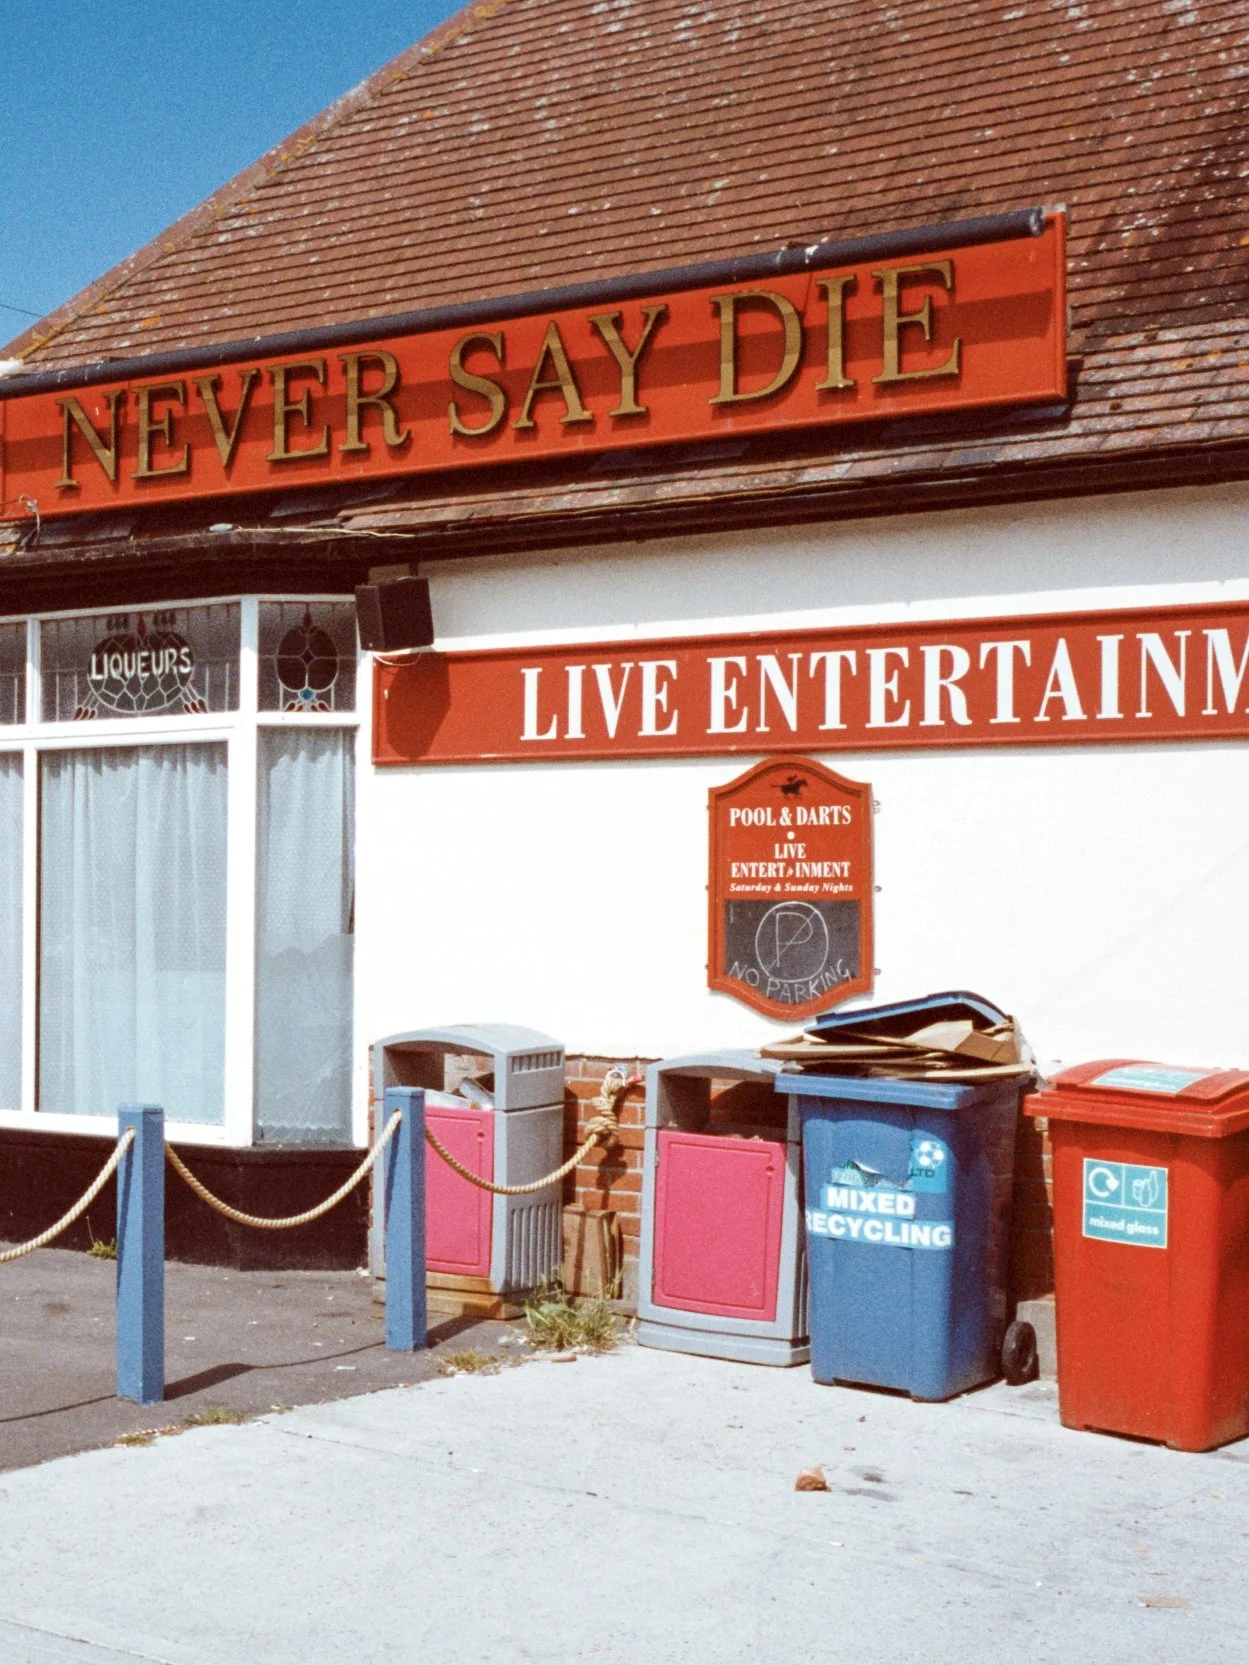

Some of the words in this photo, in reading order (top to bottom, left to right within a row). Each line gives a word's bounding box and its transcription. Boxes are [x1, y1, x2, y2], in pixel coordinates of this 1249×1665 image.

[54, 351, 411, 488] NEVER
[449, 304, 666, 436] SAY
[709, 259, 960, 405] DIE
[91, 647, 192, 680] LIQUEURS
[520, 660, 678, 741] LIVE
[706, 628, 1249, 734] ENTERTAINM
[729, 807, 776, 826] POOL
[779, 807, 792, 826] &
[795, 805, 851, 825] DARTS
[774, 843, 806, 859] LIVE
[729, 883, 772, 893] Saturday
[774, 883, 782, 892] &
[784, 883, 820, 893] Sunday
[822, 882, 854, 894] Nights
[728, 961, 760, 987] NO
[766, 959, 852, 1004] PARKING
[827, 1187, 915, 1218] MIXED
[1090, 1216, 1125, 1230] mixed
[1126, 1220, 1160, 1235] glass
